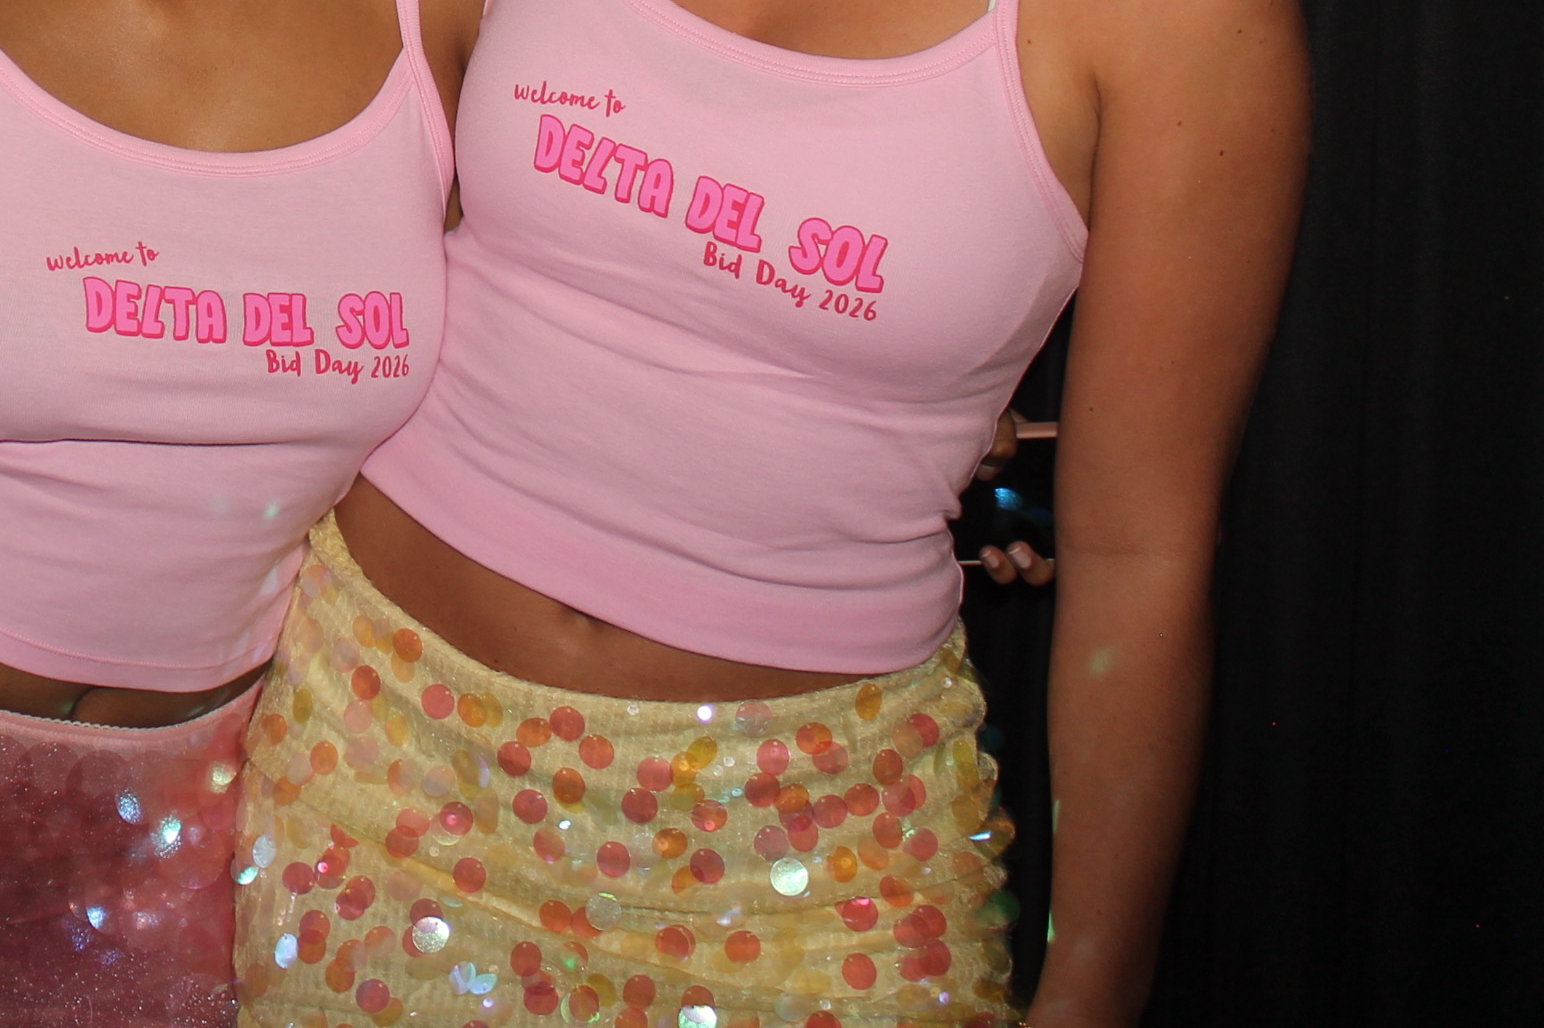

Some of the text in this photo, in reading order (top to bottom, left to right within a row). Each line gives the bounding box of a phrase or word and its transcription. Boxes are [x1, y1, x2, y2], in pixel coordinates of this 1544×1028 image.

[514, 81, 626, 117] welcome to
[533, 114, 888, 293] DELTA DEL SOL
[46, 241, 159, 271] welcome to
[703, 241, 878, 321] Bid Day 2026
[83, 276, 409, 349] DELTA DEL SOL
[265, 349, 410, 384] Bid Day 2026
